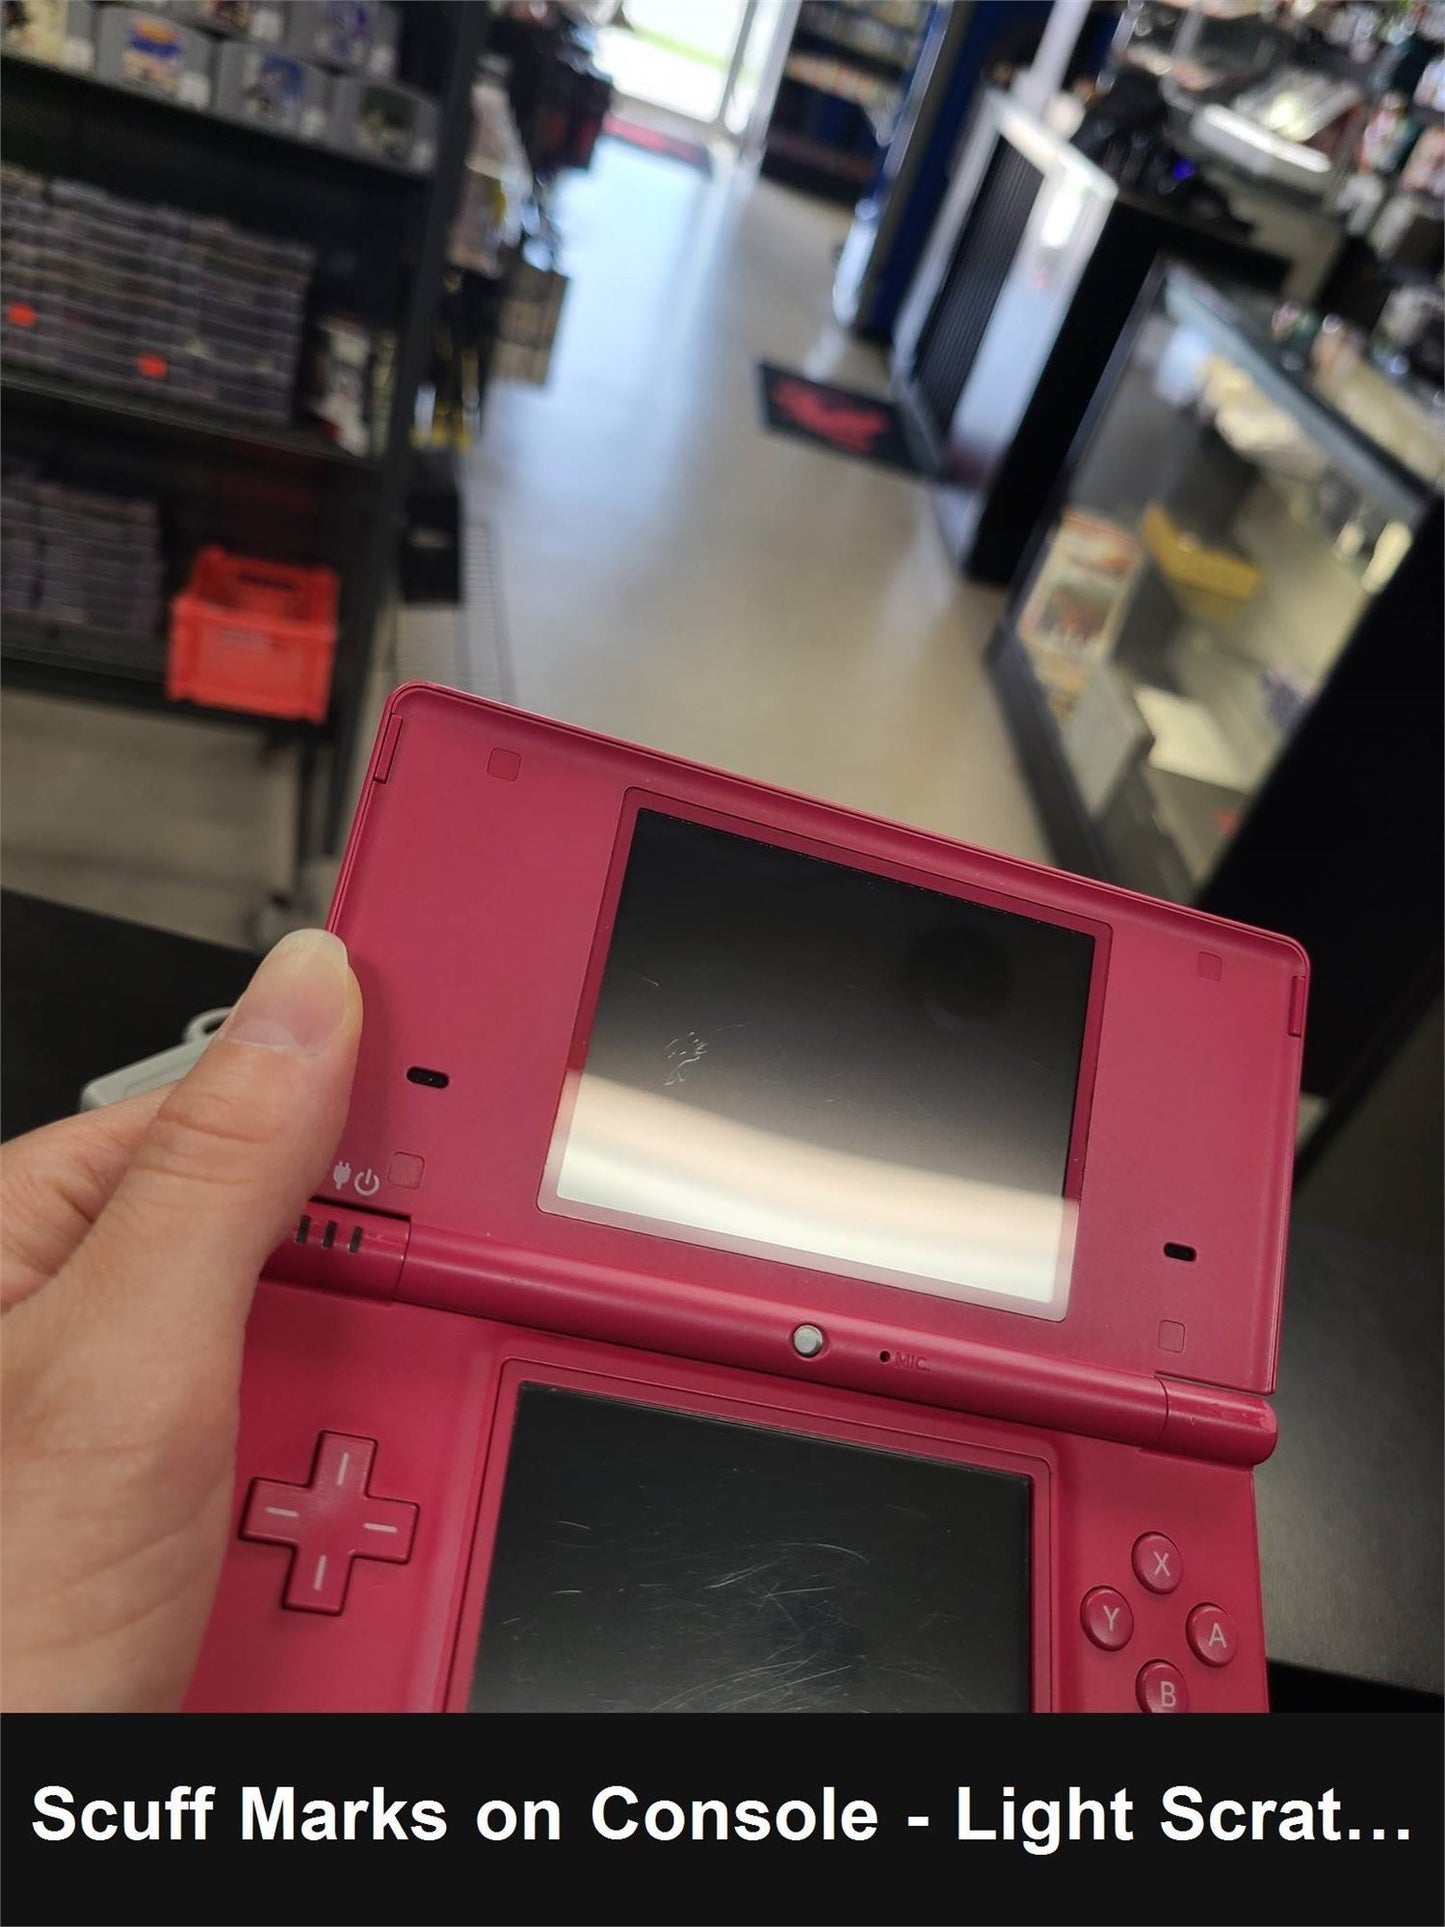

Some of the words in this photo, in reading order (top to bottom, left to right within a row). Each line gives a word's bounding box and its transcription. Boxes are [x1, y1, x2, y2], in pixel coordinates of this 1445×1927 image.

[1153, 1551, 1171, 1577] X
[1103, 1605, 1120, 1631] Y
[1208, 1622, 1228, 1648] A
[1160, 1681, 1177, 1707] B
